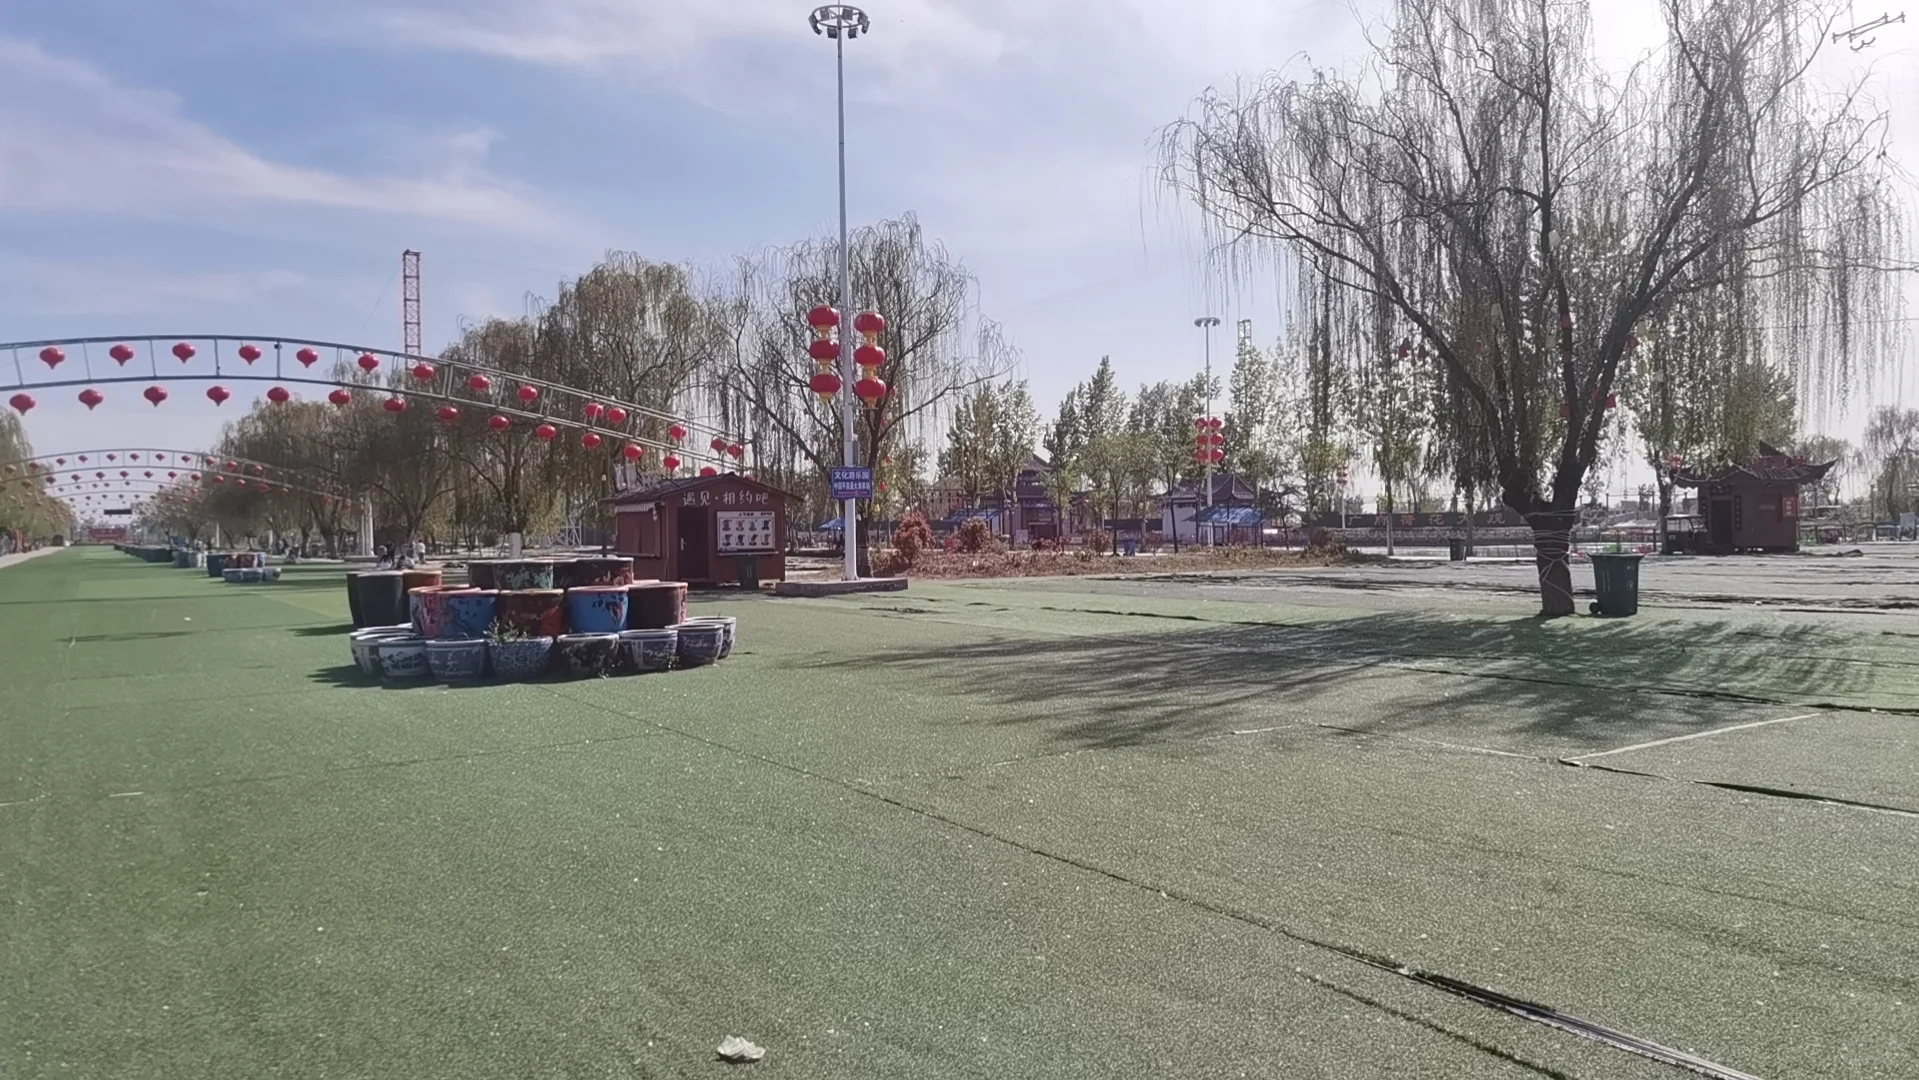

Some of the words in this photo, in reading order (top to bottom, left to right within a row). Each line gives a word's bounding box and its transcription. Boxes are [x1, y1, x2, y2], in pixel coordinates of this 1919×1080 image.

[834, 470, 870, 480] 文化游乐园
